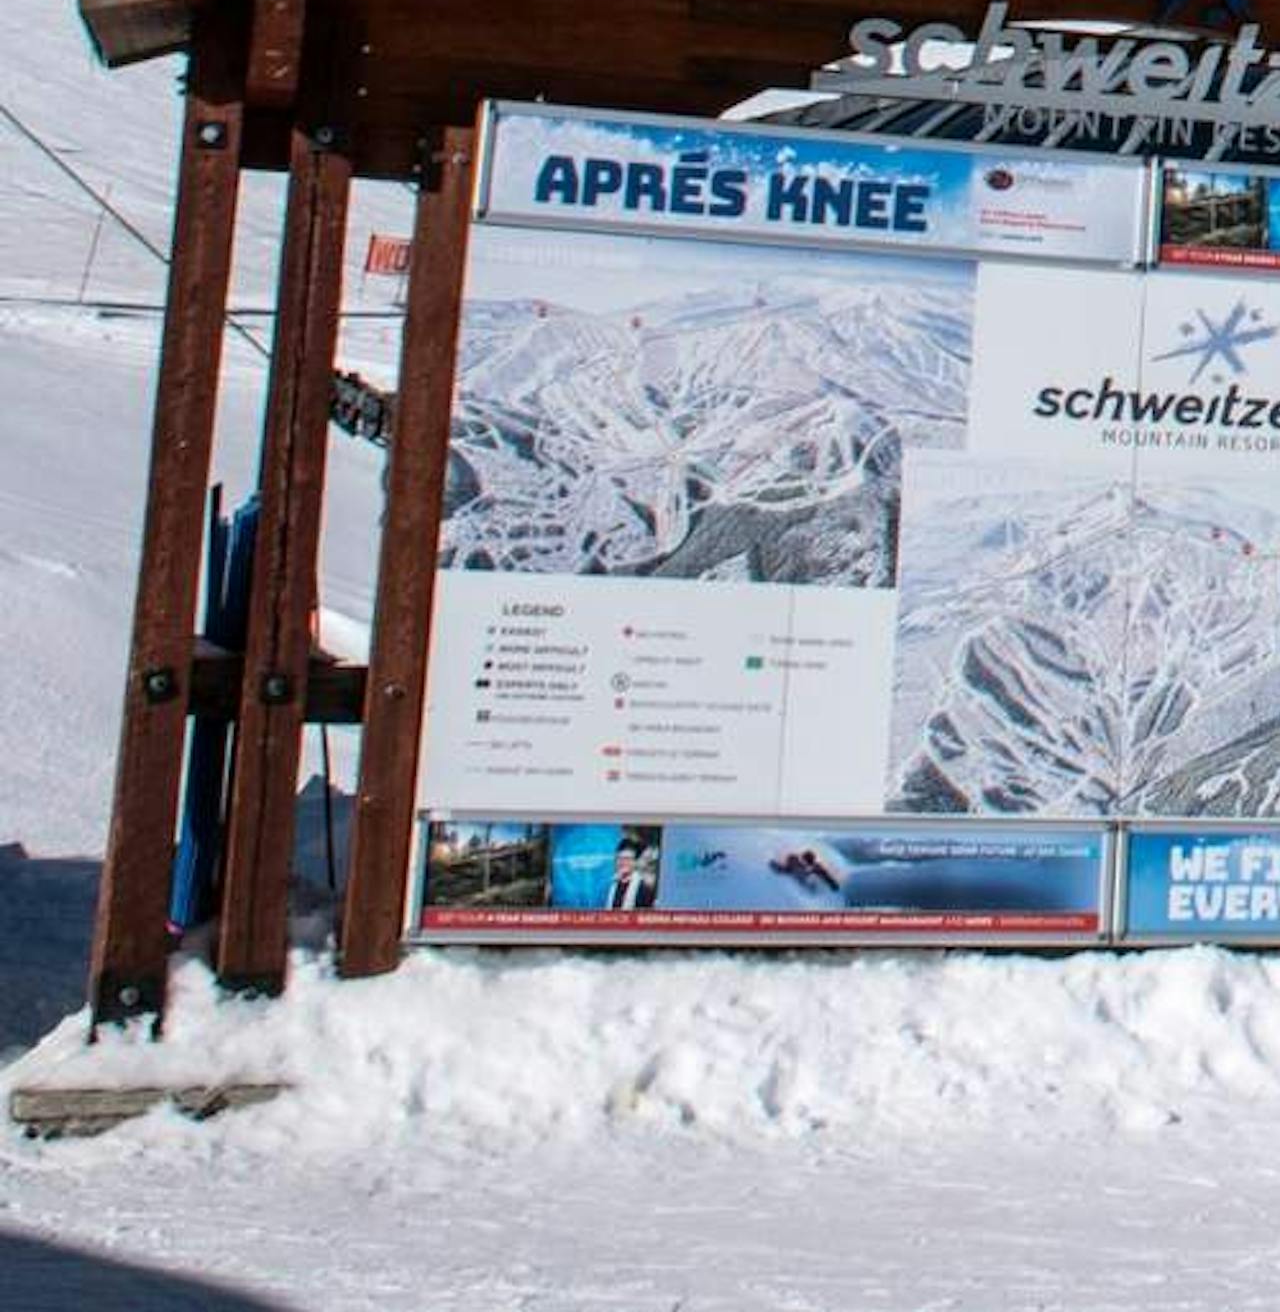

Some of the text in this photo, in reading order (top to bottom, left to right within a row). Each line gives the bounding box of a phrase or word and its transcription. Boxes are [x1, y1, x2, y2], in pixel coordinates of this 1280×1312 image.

[766, 173, 931, 232] KNEE
[1101, 428, 1208, 449] MOUNTAIN
[502, 603, 564, 617] LEGEND
[1170, 845, 1231, 881] WE
